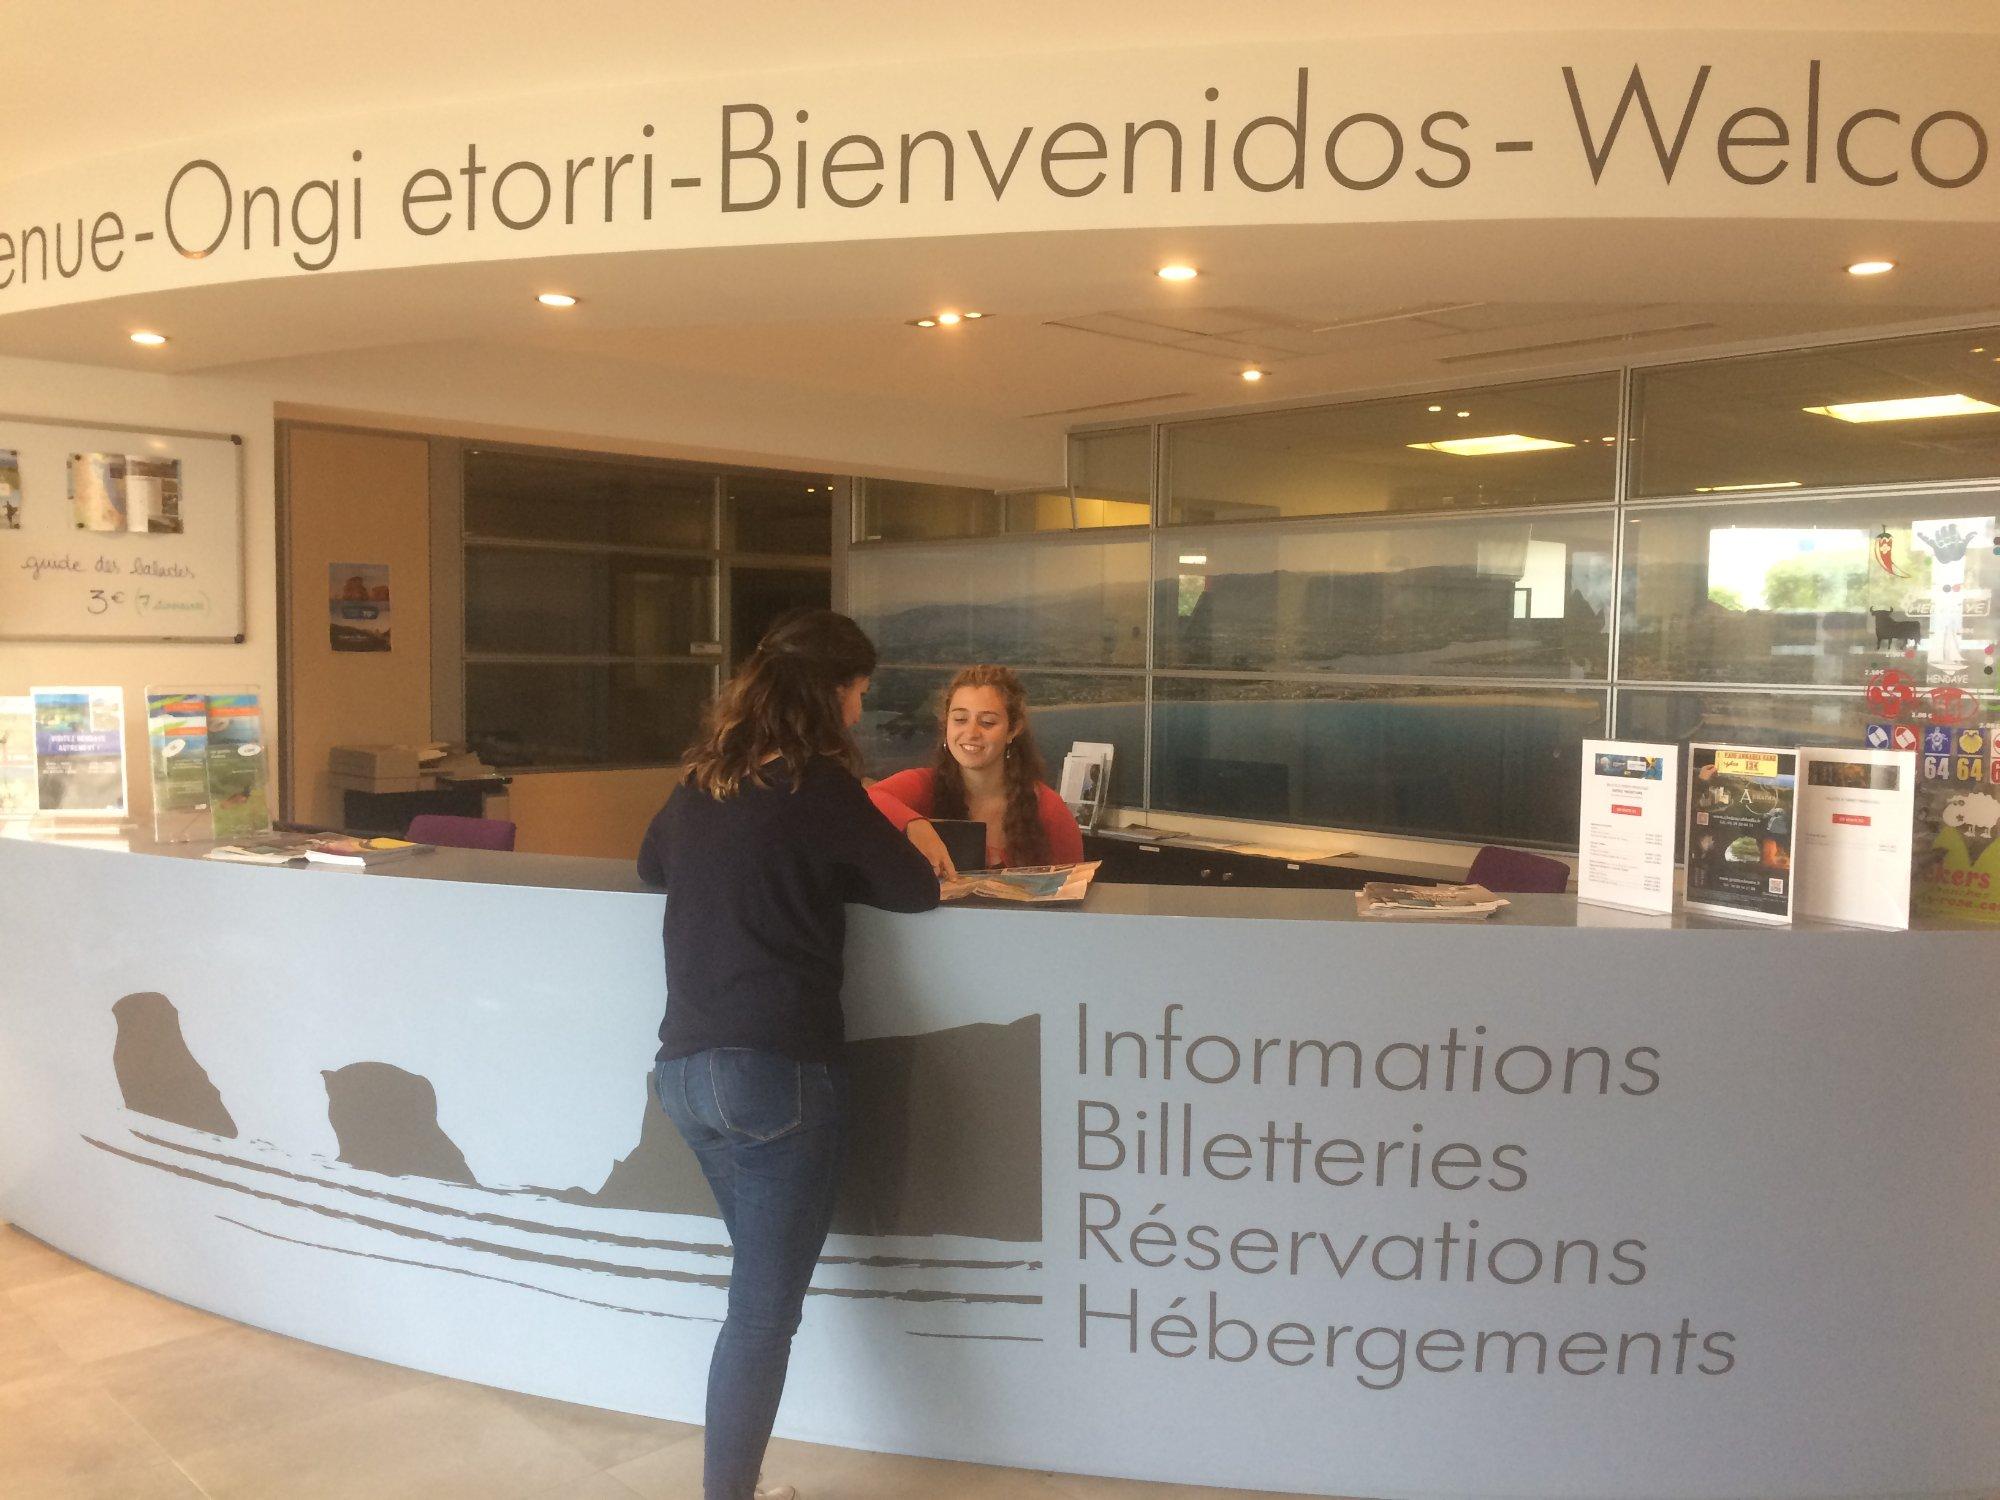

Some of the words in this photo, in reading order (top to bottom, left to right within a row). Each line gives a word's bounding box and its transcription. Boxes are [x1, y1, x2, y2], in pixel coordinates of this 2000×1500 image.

[21, 555, 86, 580] guide
[94, 555, 120, 574] des
[1926, 674, 1969, 684] HENDAYE
[1924, 756, 1950, 780] 64
[1956, 757, 1983, 781] 64
[1078, 1002, 1661, 1096] Informations
[1077, 1099, 1529, 1192] Billetteries
[1078, 1191, 1647, 1286] Réservations
[1078, 1282, 1737, 1391] Hébergements
